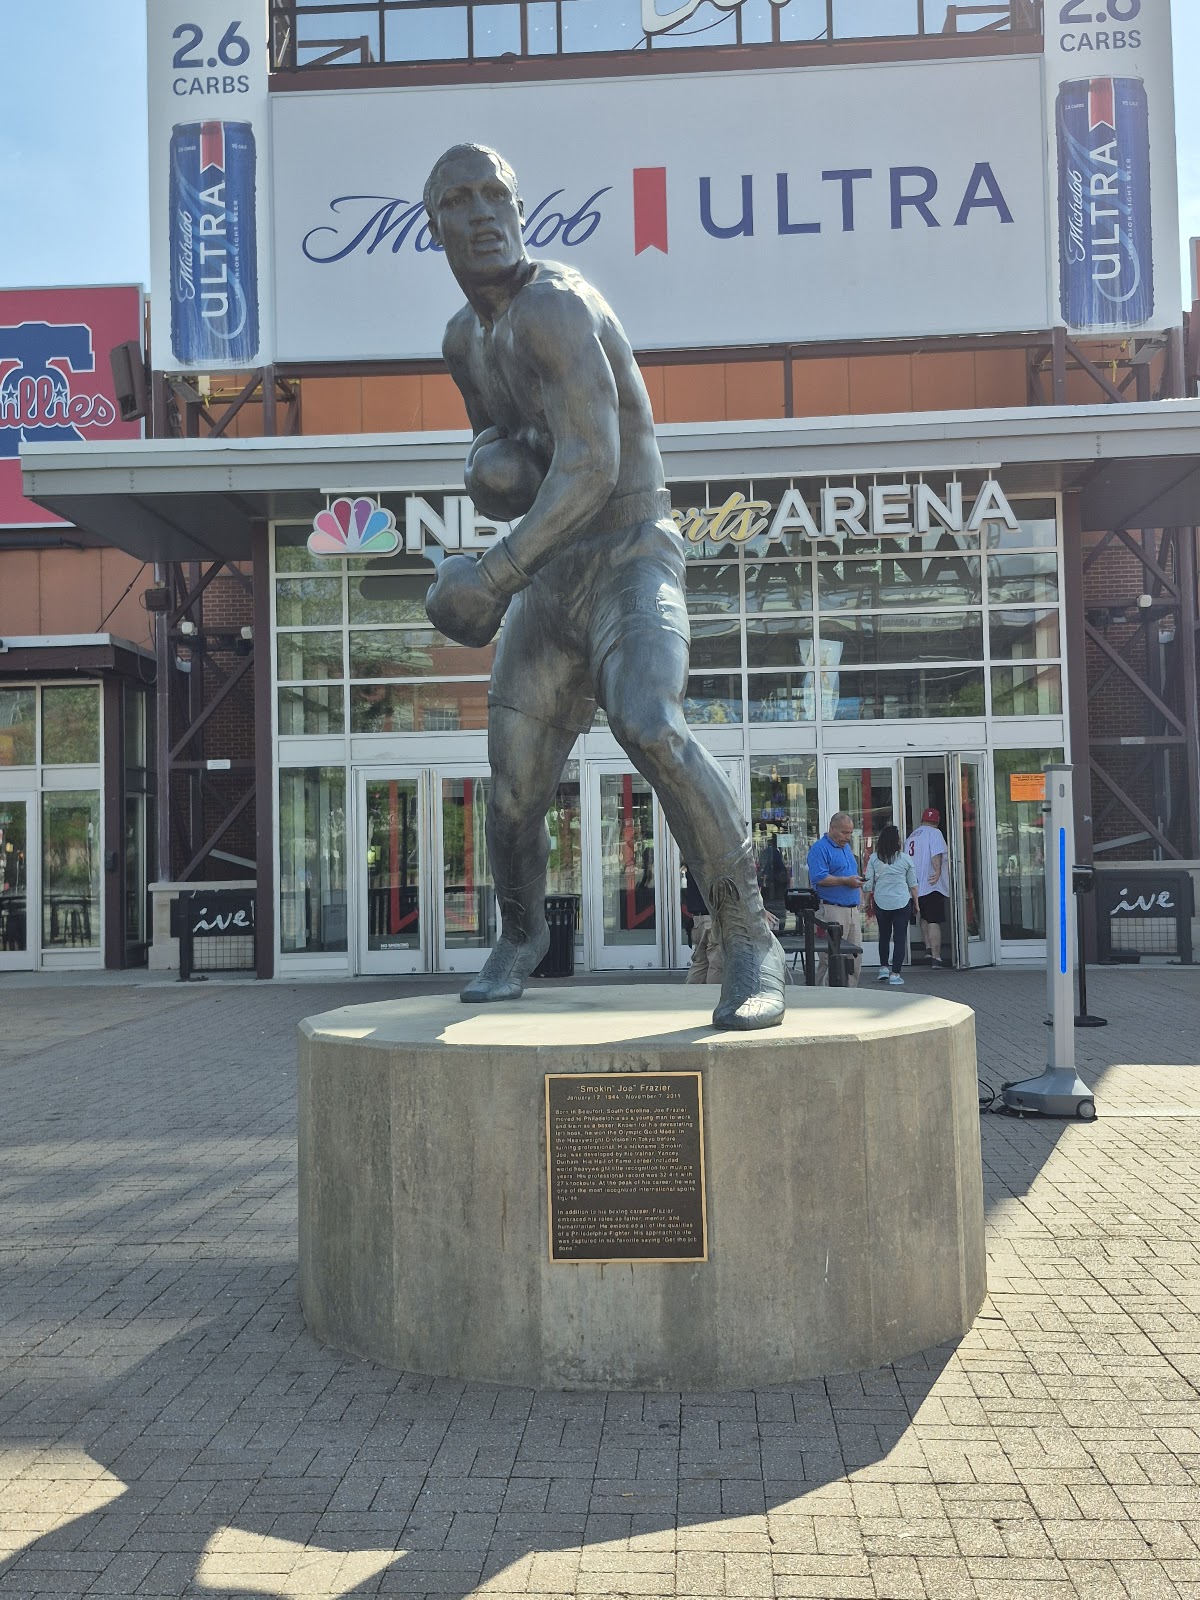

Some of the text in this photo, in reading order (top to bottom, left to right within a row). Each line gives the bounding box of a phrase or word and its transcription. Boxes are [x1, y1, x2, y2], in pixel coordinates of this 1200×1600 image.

[172, 21, 250, 69] 2.6
[1060, 30, 1142, 52] CARBS
[172, 75, 249, 96] CARBS
[302, 162, 1015, 263] Milob ULTRA
[1067, 170, 1086, 265] Michelob
[1089, 139, 1121, 280] ULTRA
[178, 210, 196, 305] Michelob
[199, 181, 229, 318] ULTRA
[0, 375, 116, 429] illies
[405, 496, 525, 554] NB
[768, 480, 1022, 541] ARENA
[640, 1083, 670, 1091] Frazier
